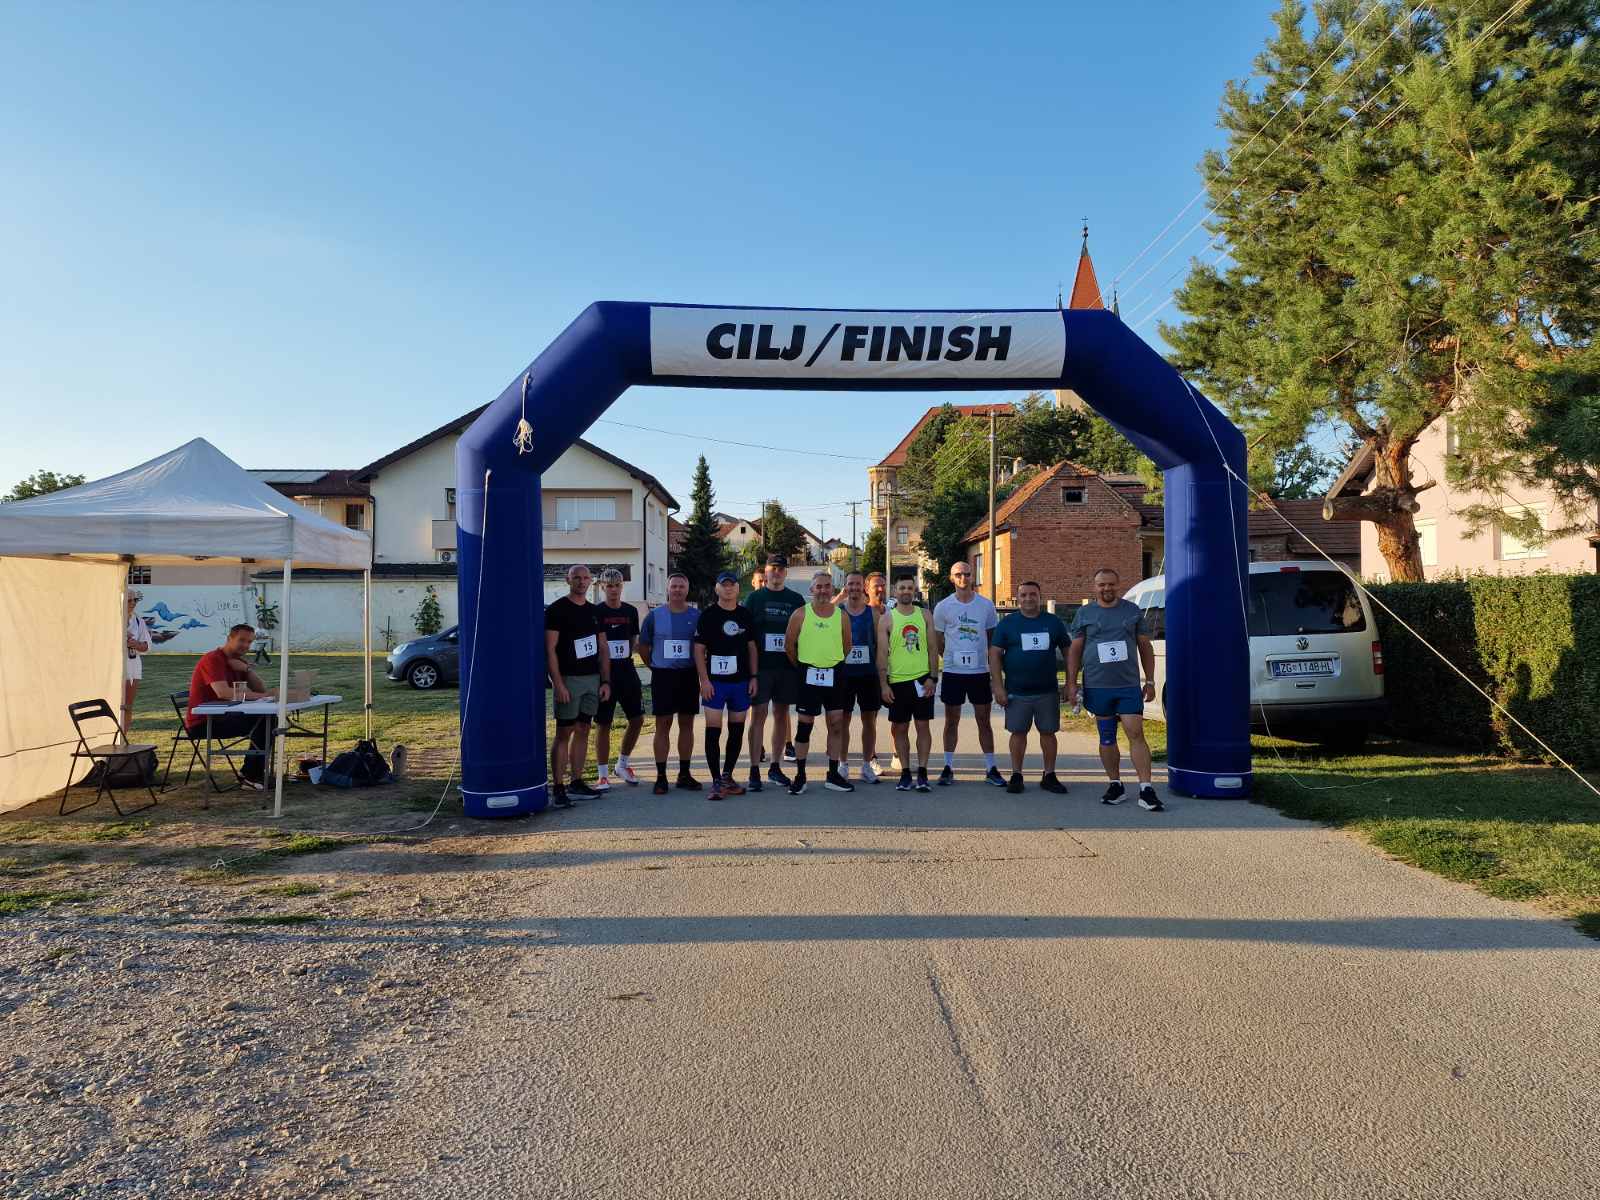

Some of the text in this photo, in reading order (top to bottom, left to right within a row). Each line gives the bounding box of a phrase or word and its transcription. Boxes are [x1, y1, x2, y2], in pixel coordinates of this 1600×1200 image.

[705, 322, 1013, 367] CILJ/FINISH
[583, 641, 593, 652] 15
[774, 638, 784, 648] 16
[672, 644, 683, 654] 18
[1110, 647, 1117, 657] 3
[852, 650, 863, 659] 20
[961, 655, 971, 665] 11
[718, 661, 729, 670] 17
[815, 673, 825, 681] 14
